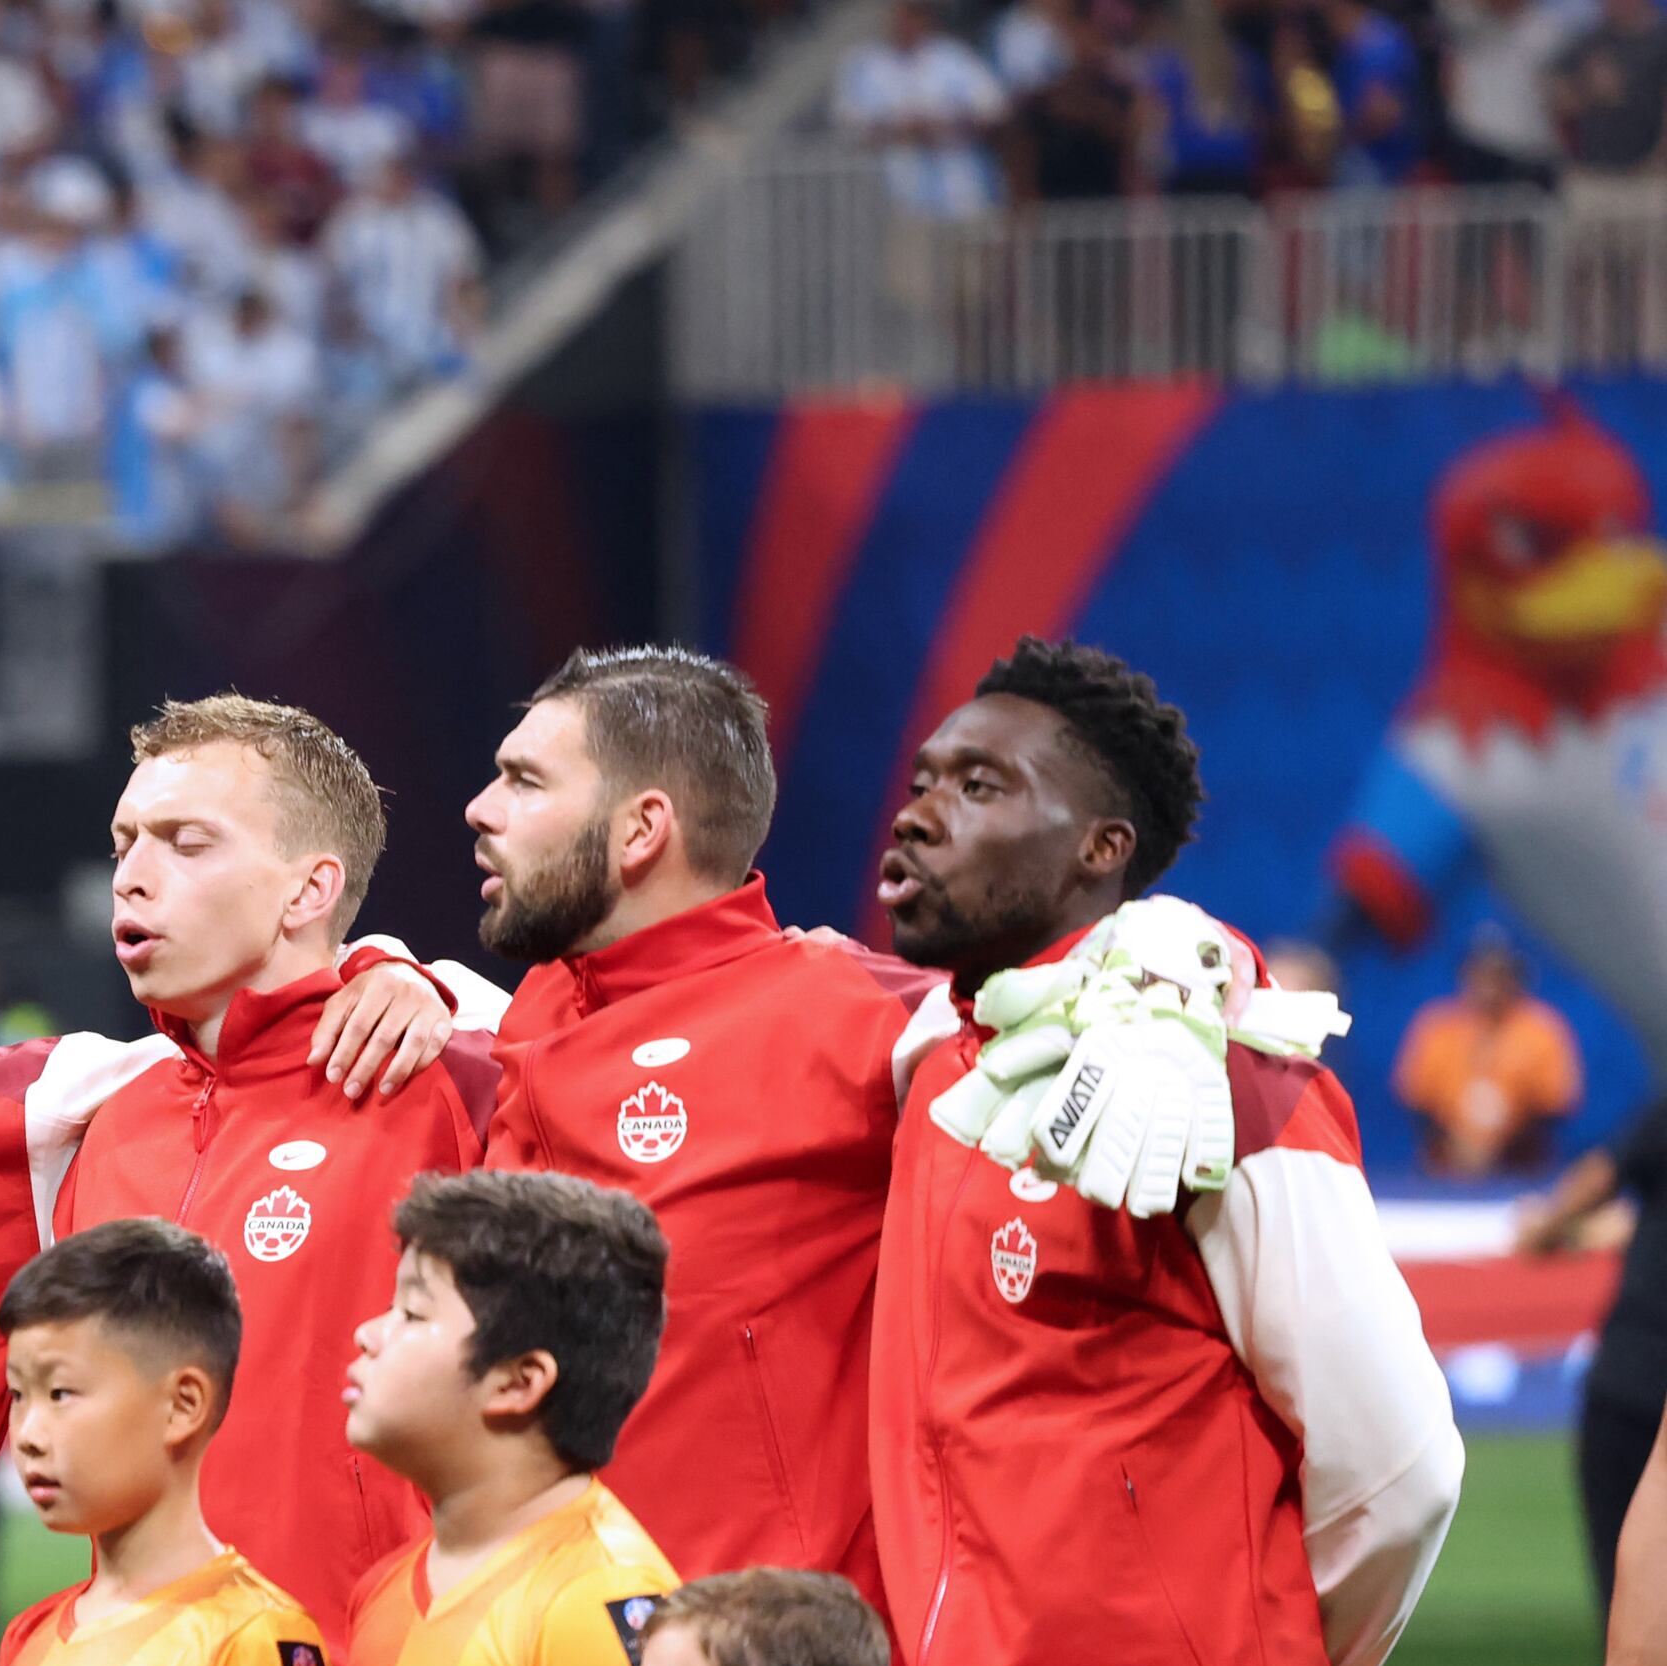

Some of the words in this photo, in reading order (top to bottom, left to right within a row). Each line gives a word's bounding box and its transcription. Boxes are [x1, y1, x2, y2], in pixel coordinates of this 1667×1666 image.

[621, 1119, 683, 1130] CANADA
[248, 1221, 305, 1231] CANADA
[994, 1254, 1031, 1270] CANADA
